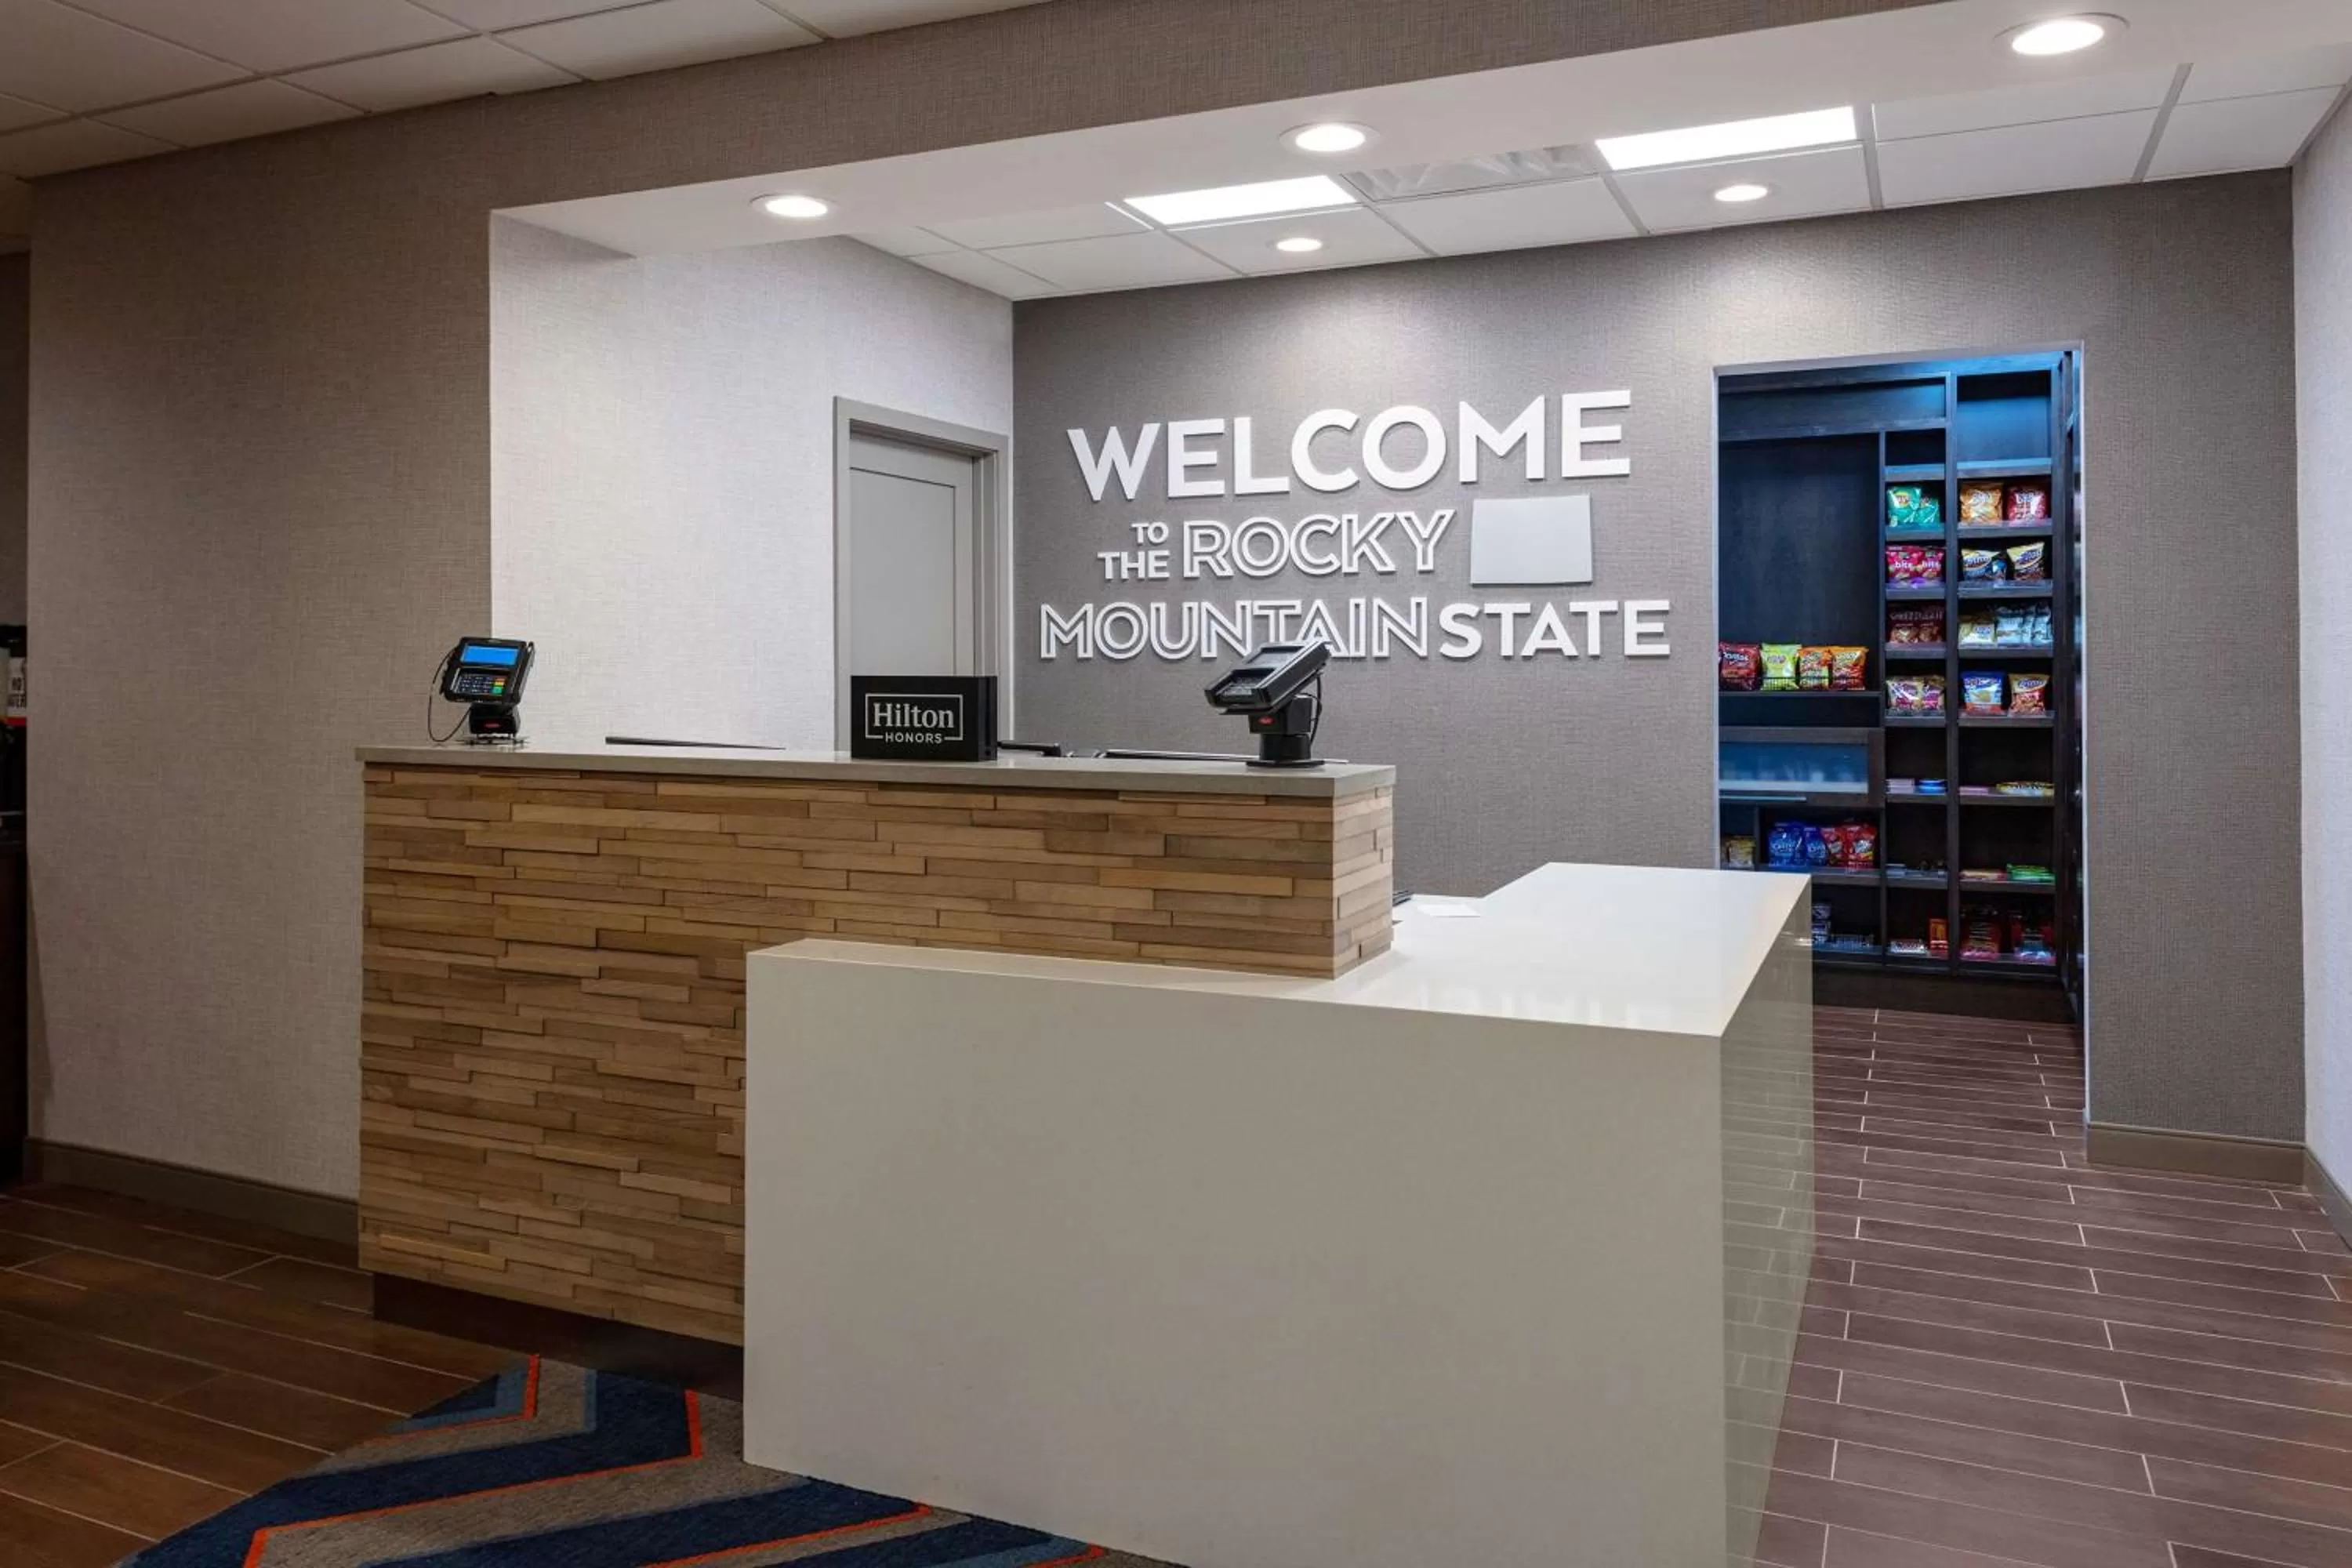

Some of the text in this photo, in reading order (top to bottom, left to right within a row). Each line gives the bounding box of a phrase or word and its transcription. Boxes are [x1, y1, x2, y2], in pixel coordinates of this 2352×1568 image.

[1067, 390, 1632, 500] WELCOME
[1098, 508, 1456, 579] THE ROCKY
[1131, 521, 1169, 544] TO
[1040, 596, 1671, 660] MOUNTAIN STATE
[873, 702, 954, 728] Hilton
[885, 731, 942, 744] HONORS
